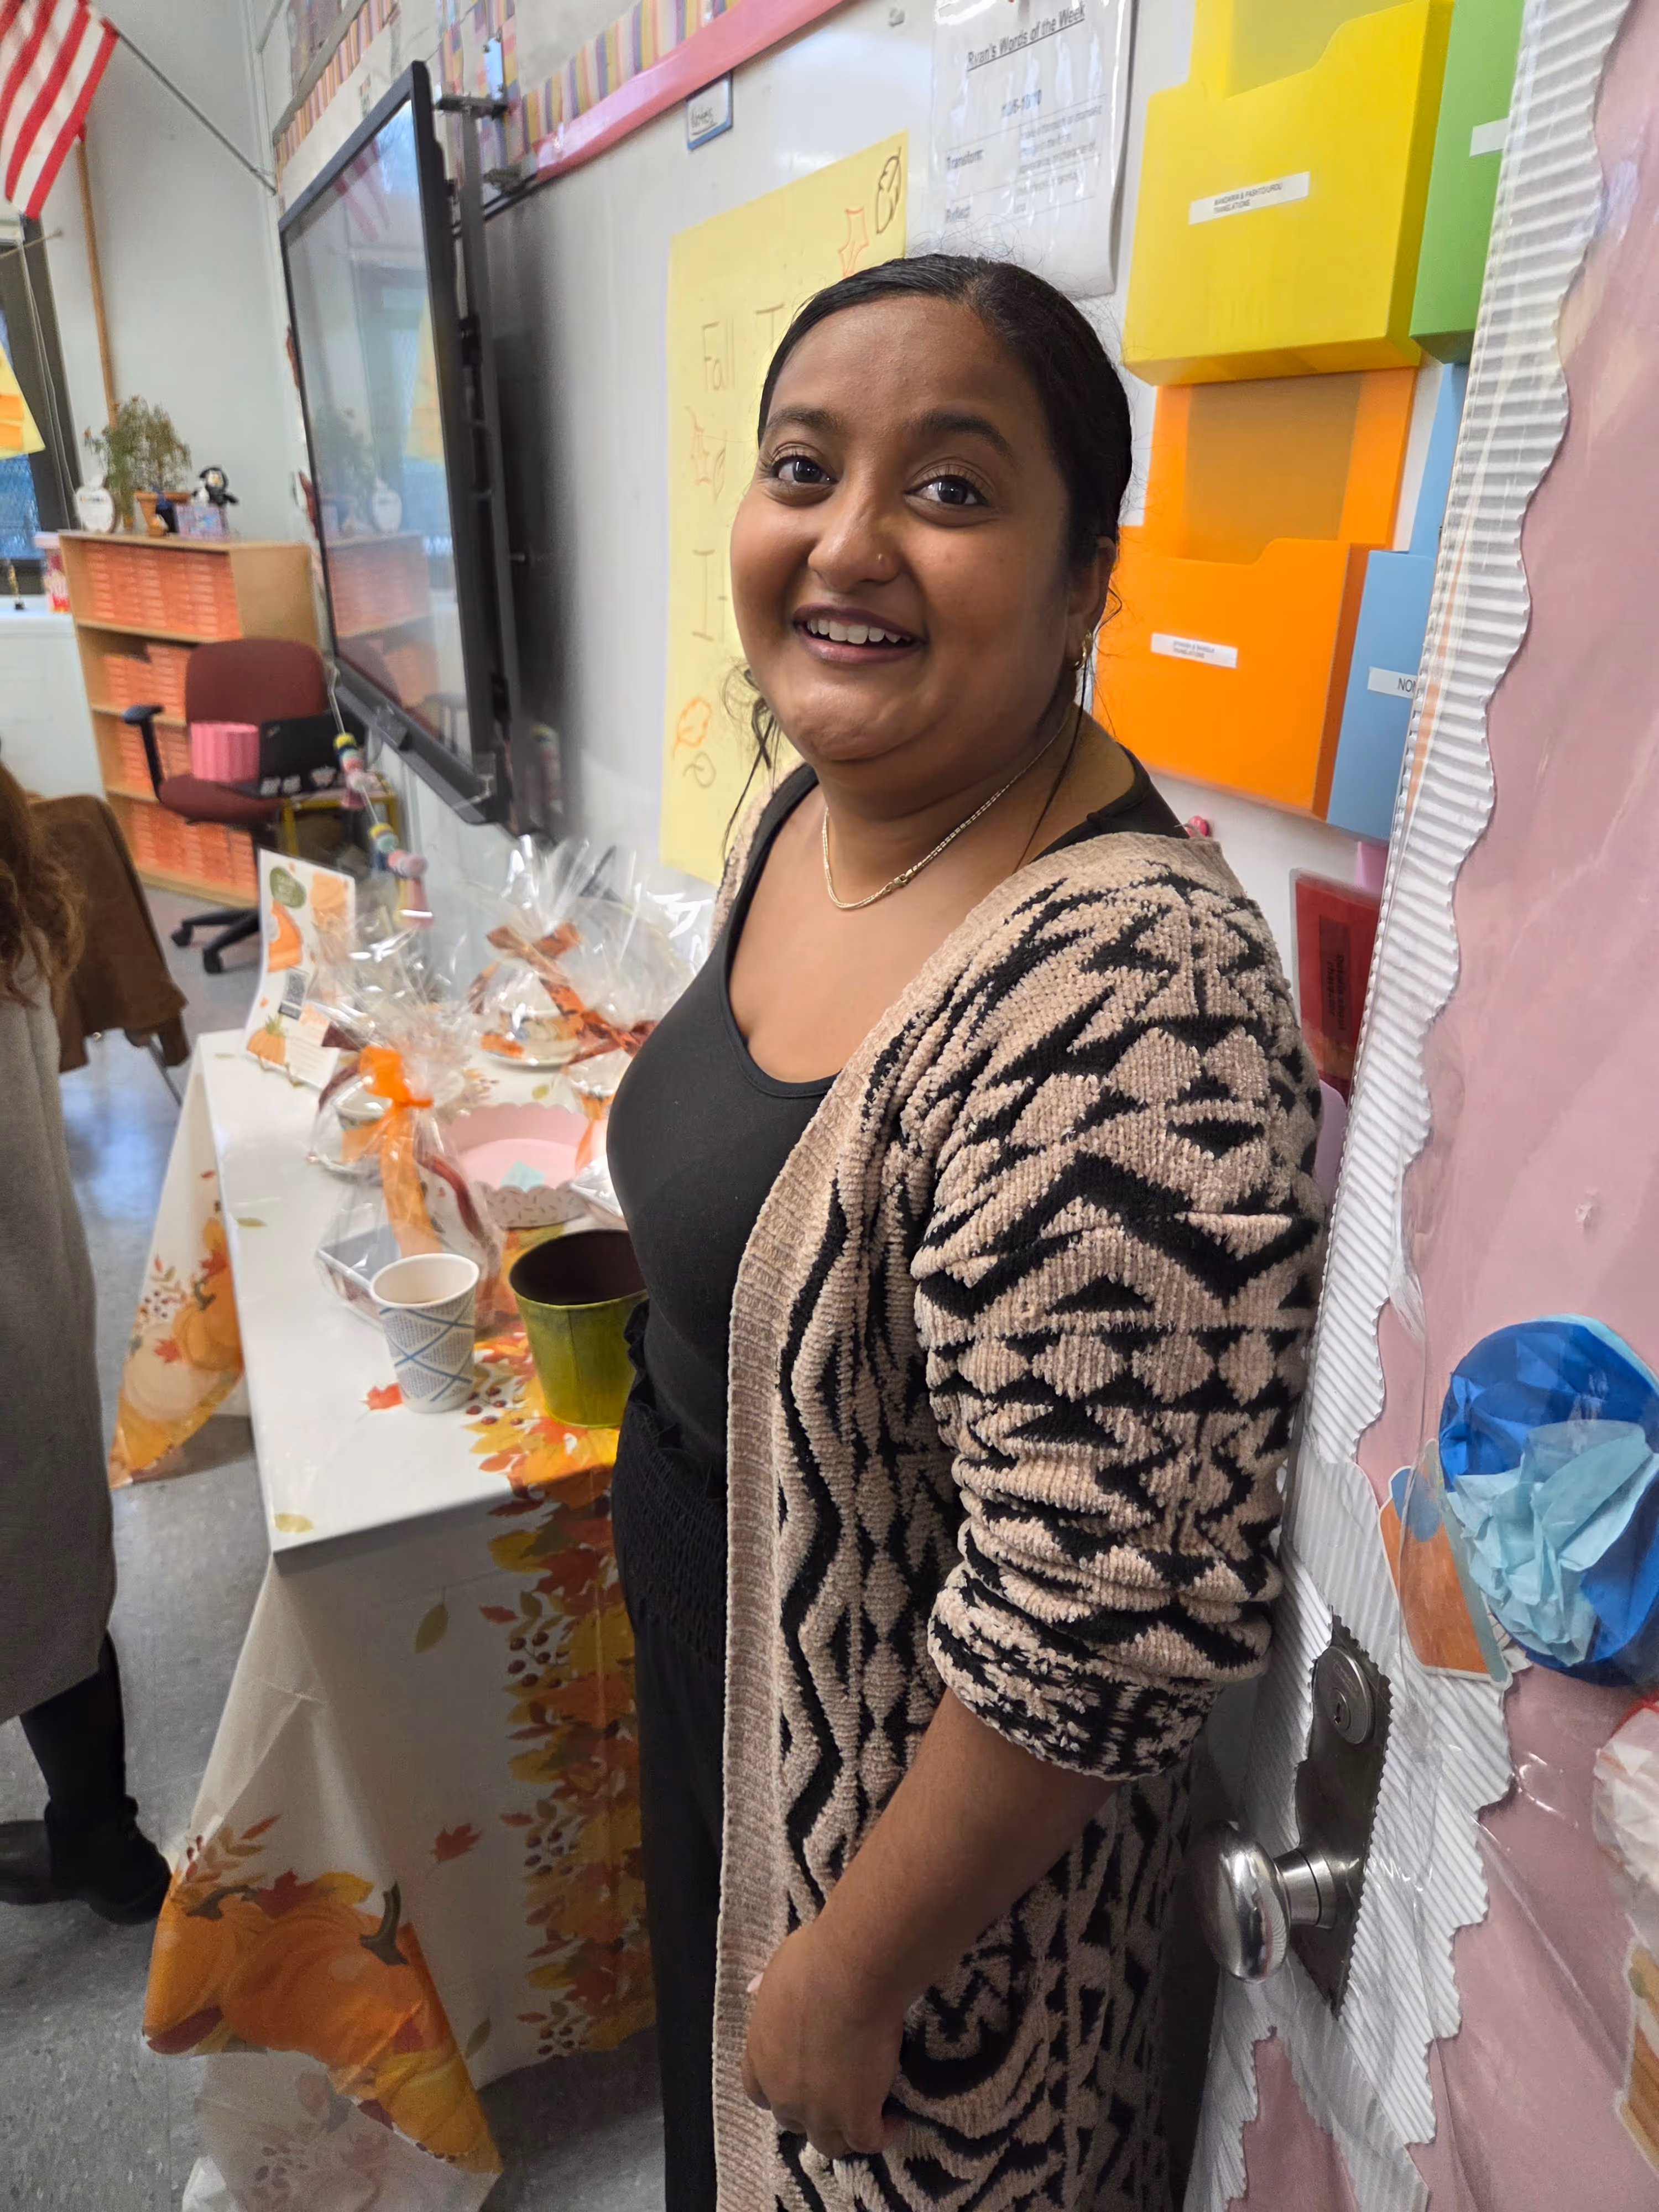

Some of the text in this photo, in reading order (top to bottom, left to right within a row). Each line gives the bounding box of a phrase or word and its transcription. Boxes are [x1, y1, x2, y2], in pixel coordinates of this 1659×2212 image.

[968, 3, 1086, 66] Ryan's Words of the Week
[702, 316, 735, 392] Fall
